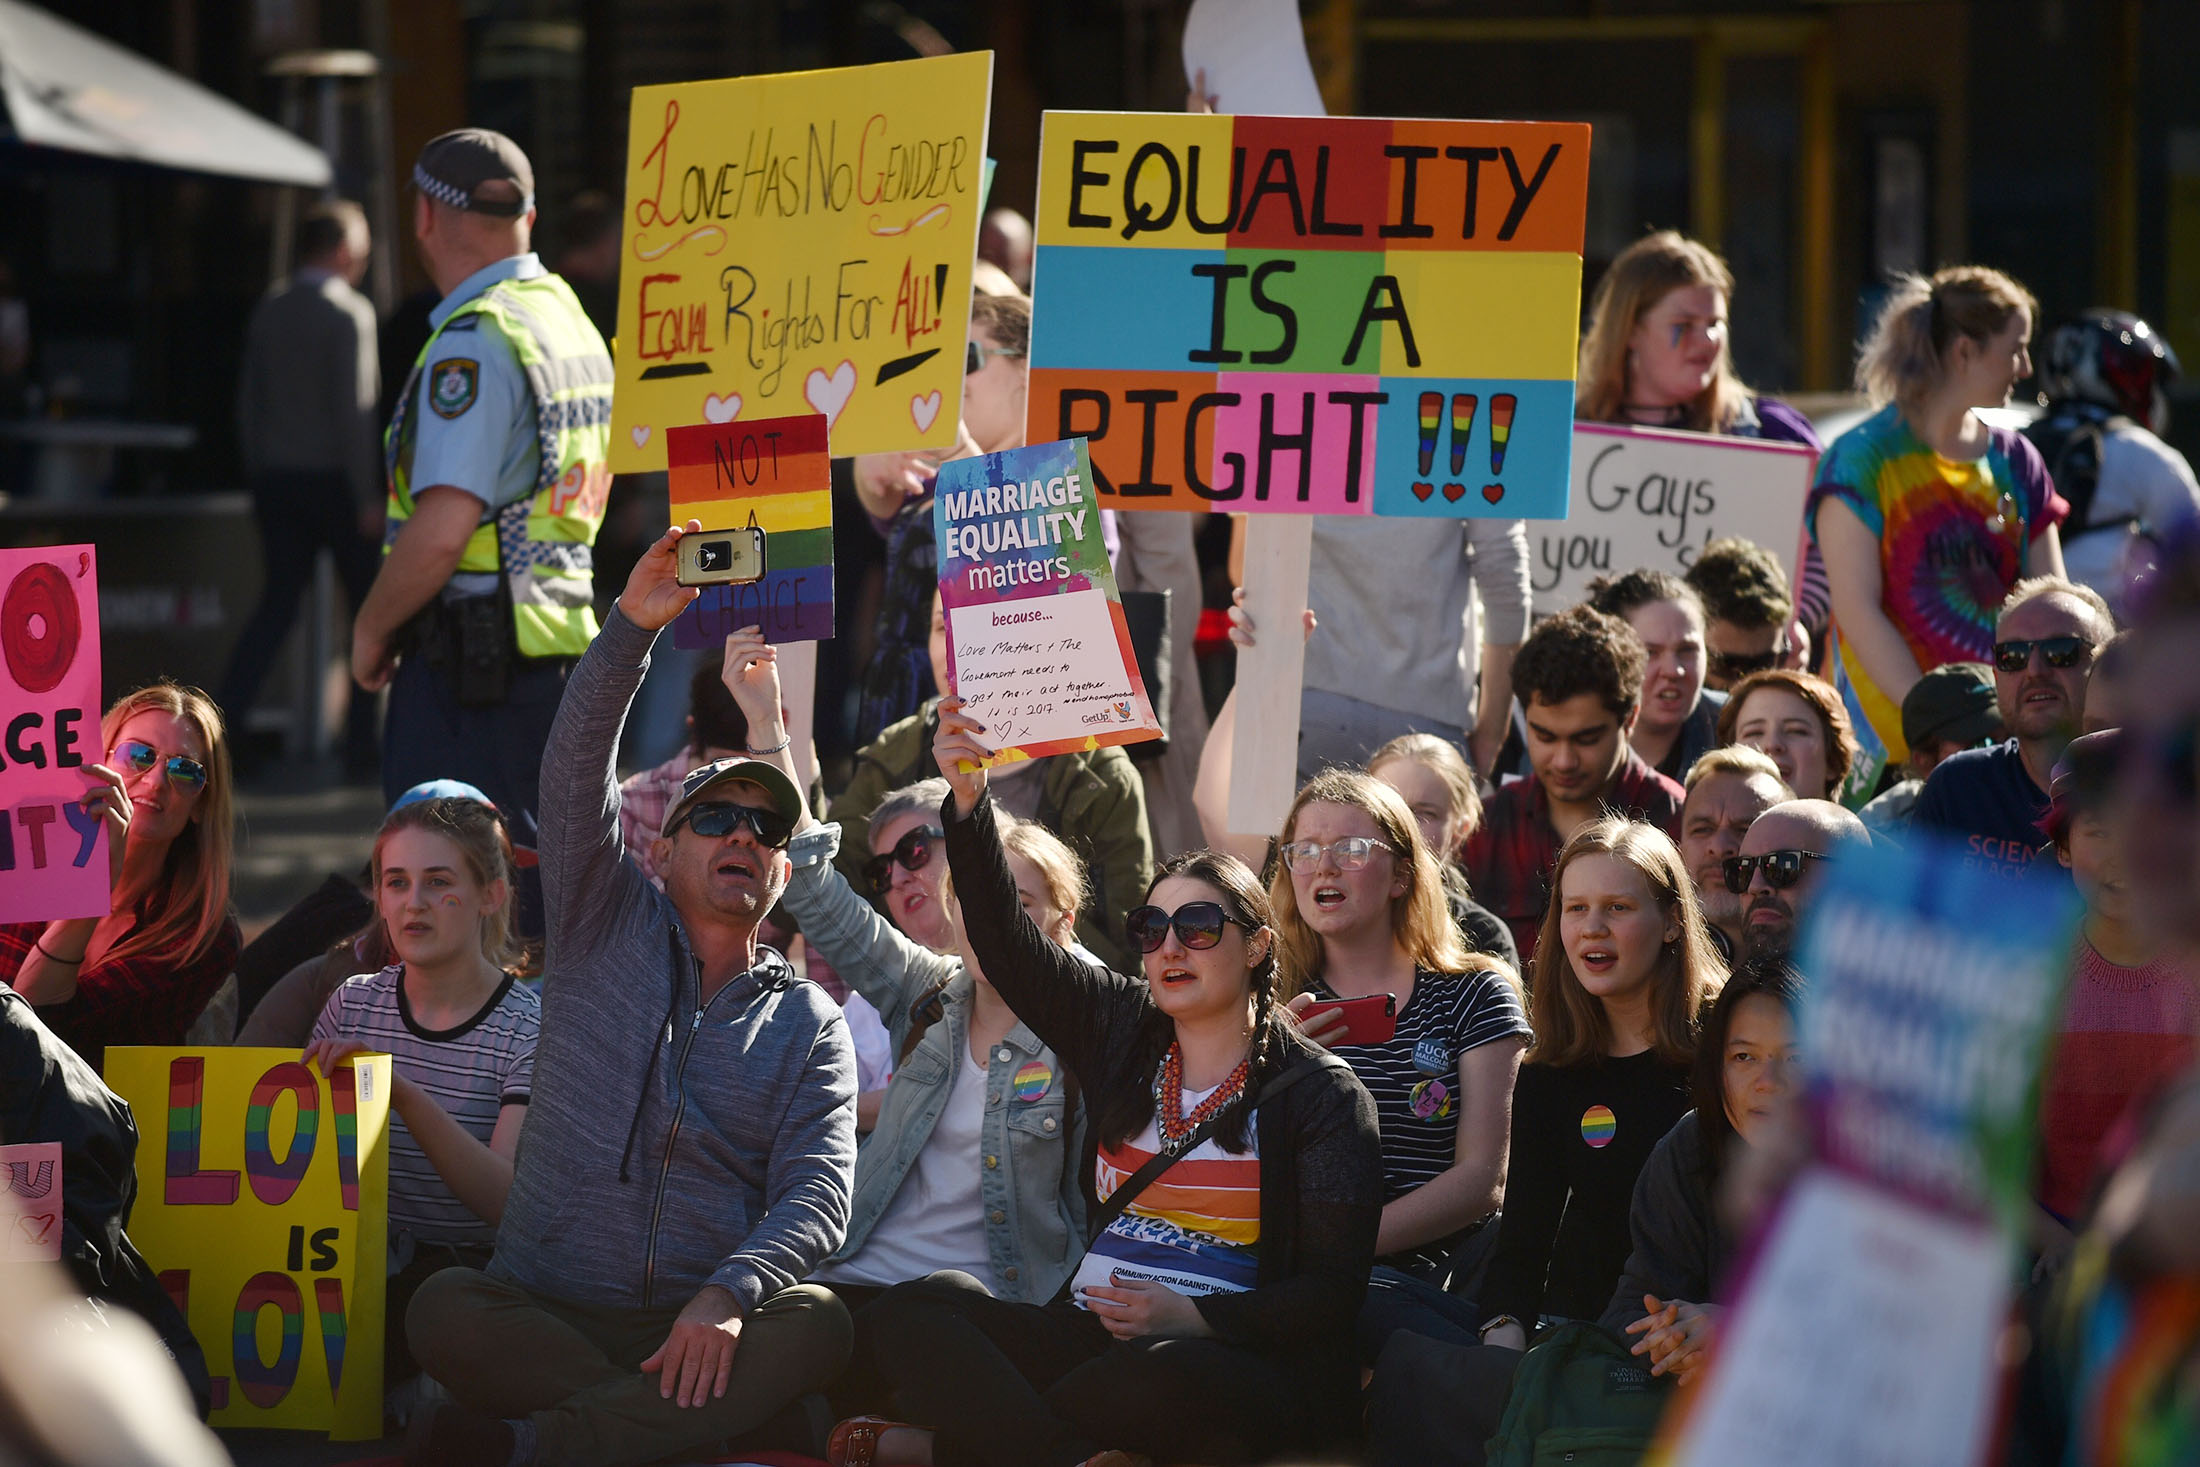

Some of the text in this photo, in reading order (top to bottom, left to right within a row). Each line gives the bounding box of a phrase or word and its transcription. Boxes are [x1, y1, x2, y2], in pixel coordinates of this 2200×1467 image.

[857, 113, 969, 206] GENDER
[1067, 139, 1563, 242] EQUALITY
[637, 272, 715, 362] EQUAL
[720, 265, 824, 399] Rights
[1188, 260, 1422, 368] IS A
[714, 431, 783, 491] NOT
[1056, 388, 1390, 504] RIGHT
[944, 474, 1084, 522] MARRIAGE
[1587, 444, 1716, 548] Gays
[945, 509, 1087, 562] EQUALITY
[1531, 534, 1612, 592] you
[968, 556, 1072, 591] matters
[695, 577, 808, 638] CHOICE
[957, 642, 986, 658] Love
[991, 641, 1042, 656] Matters
[1058, 638, 1084, 652] The
[1021, 664, 1055, 677] needs
[1060, 663, 1071, 673] to
[968, 690, 994, 709] get
[1001, 688, 1033, 700] their
[1039, 684, 1060, 696] act
[0, 708, 83, 770] GE
[1414, 1051, 1449, 1068] MALCOLM
[1417, 1041, 1450, 1061] FUCK
[287, 1225, 340, 1272] IS
[1112, 1266, 1153, 1282] COMMUNITY
[1152, 1274, 1178, 1286] ACTION
[1178, 1278, 1211, 1293] AGAINST
